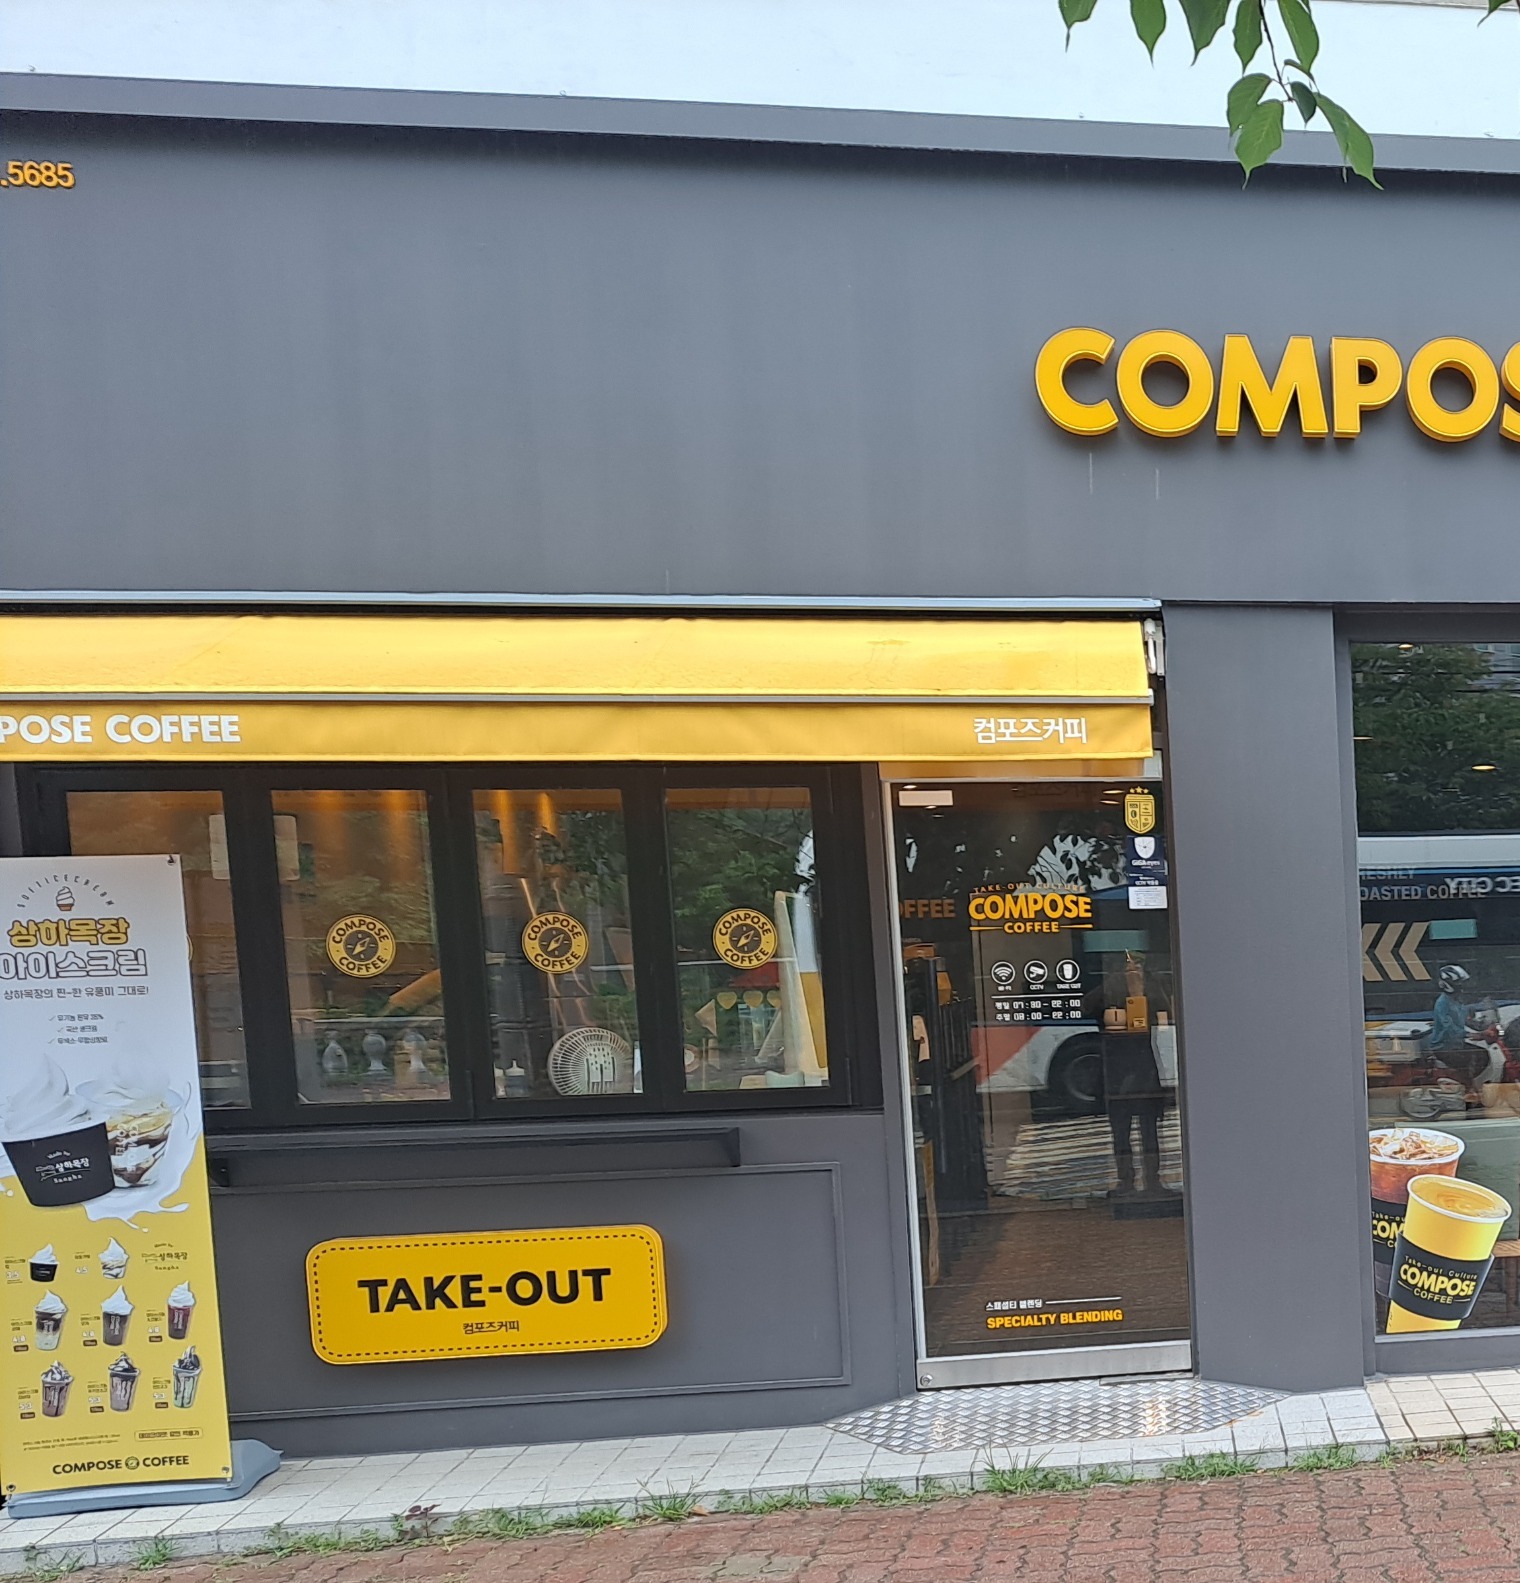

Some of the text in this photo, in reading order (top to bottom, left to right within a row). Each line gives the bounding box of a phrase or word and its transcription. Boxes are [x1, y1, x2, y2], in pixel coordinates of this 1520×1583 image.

[0, 715, 241, 744] POSE COFFEE
[973, 717, 1088, 744] 컴포즈커피
[899, 899, 956, 918] FFEE
[969, 892, 1092, 919] COMPOSE
[8, 918, 129, 947] 상하목장
[332, 919, 389, 944] COMPOSE
[527, 916, 582, 941] COMPOSE
[718, 912, 772, 936] COMPOSE
[1004, 921, 1060, 933] COFFEE
[0, 949, 148, 980] 아이스크림
[339, 954, 387, 972] COFFEE
[534, 951, 581, 969] COFFEE
[724, 948, 769, 965] COFFEE
[4, 989, 53, 1000] 상하목장의
[1372, 1211, 1405, 1221] Take-ou
[1372, 1219, 1405, 1240] COM
[1405, 1255, 1443, 1274] Take-out
[1400, 1264, 1477, 1296] COMPOSE
[357, 1268, 612, 1313] TAKE-OUT
[1413, 1288, 1454, 1304] COFFEE
[463, 1320, 520, 1335] 컴포즈커피
[987, 1309, 1123, 1329] SPECIALTY BLENDING
[53, 1455, 189, 1475] COMPOSE COFFEE
